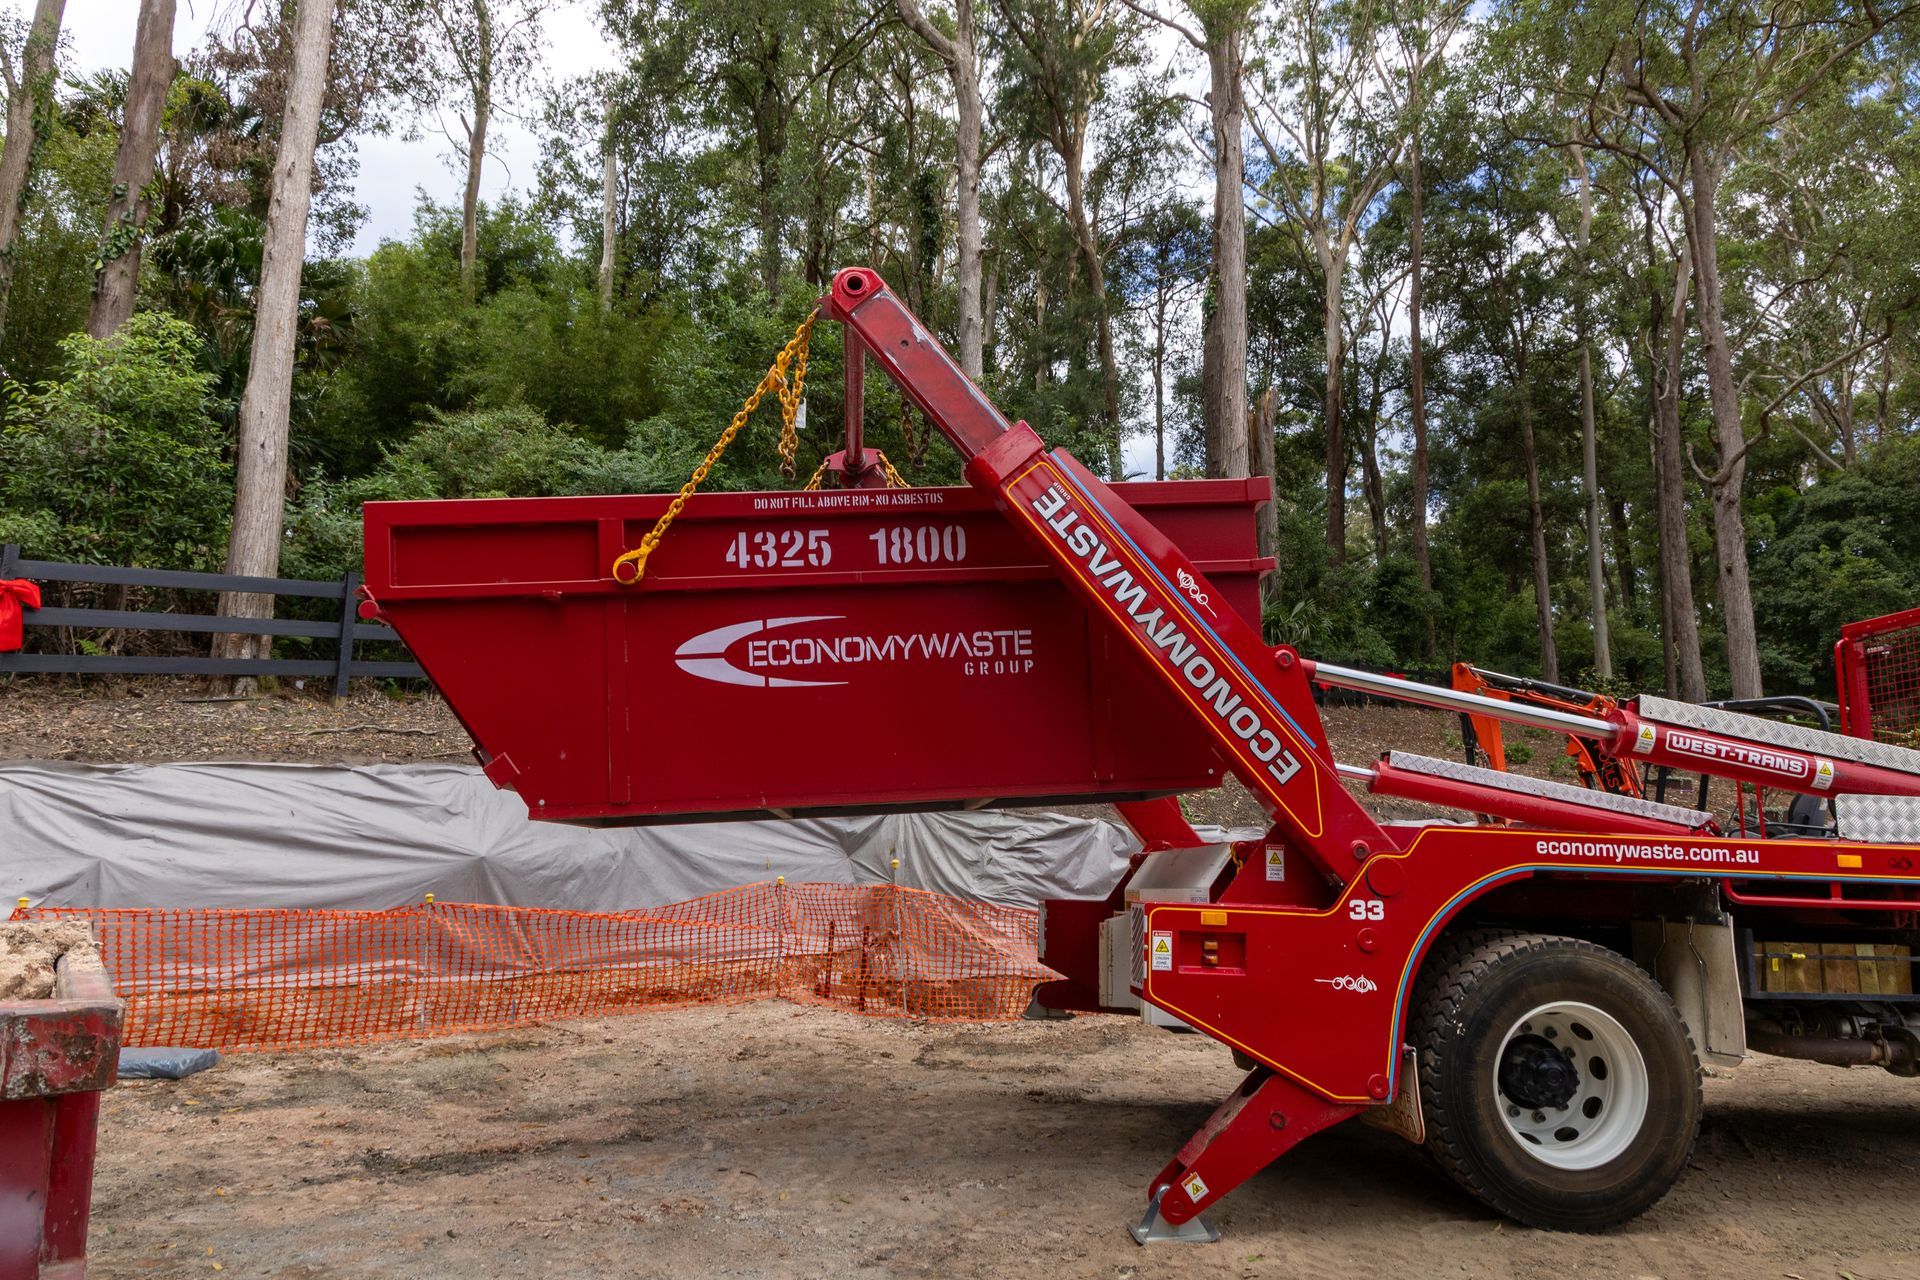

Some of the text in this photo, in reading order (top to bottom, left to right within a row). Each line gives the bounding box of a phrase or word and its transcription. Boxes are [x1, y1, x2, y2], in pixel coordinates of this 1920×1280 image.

[754, 498, 768, 510] DO
[770, 497, 790, 510] NOT
[792, 496, 815, 509] FILL
[817, 495, 851, 508] ABOVE
[891, 492, 943, 505] ASBESTOS
[1053, 481, 1071, 501] GROUP
[725, 525, 966, 569] 4325 1800
[1032, 486, 1302, 785] ECONOMYWASTE
[748, 629, 1034, 667] ECONOMYWASTE
[964, 659, 1034, 676] GROUP
[1672, 735, 1803, 773] WEST-TRANS
[1536, 840, 1760, 863] economywaste.com.au
[1349, 899, 1385, 921] 33
